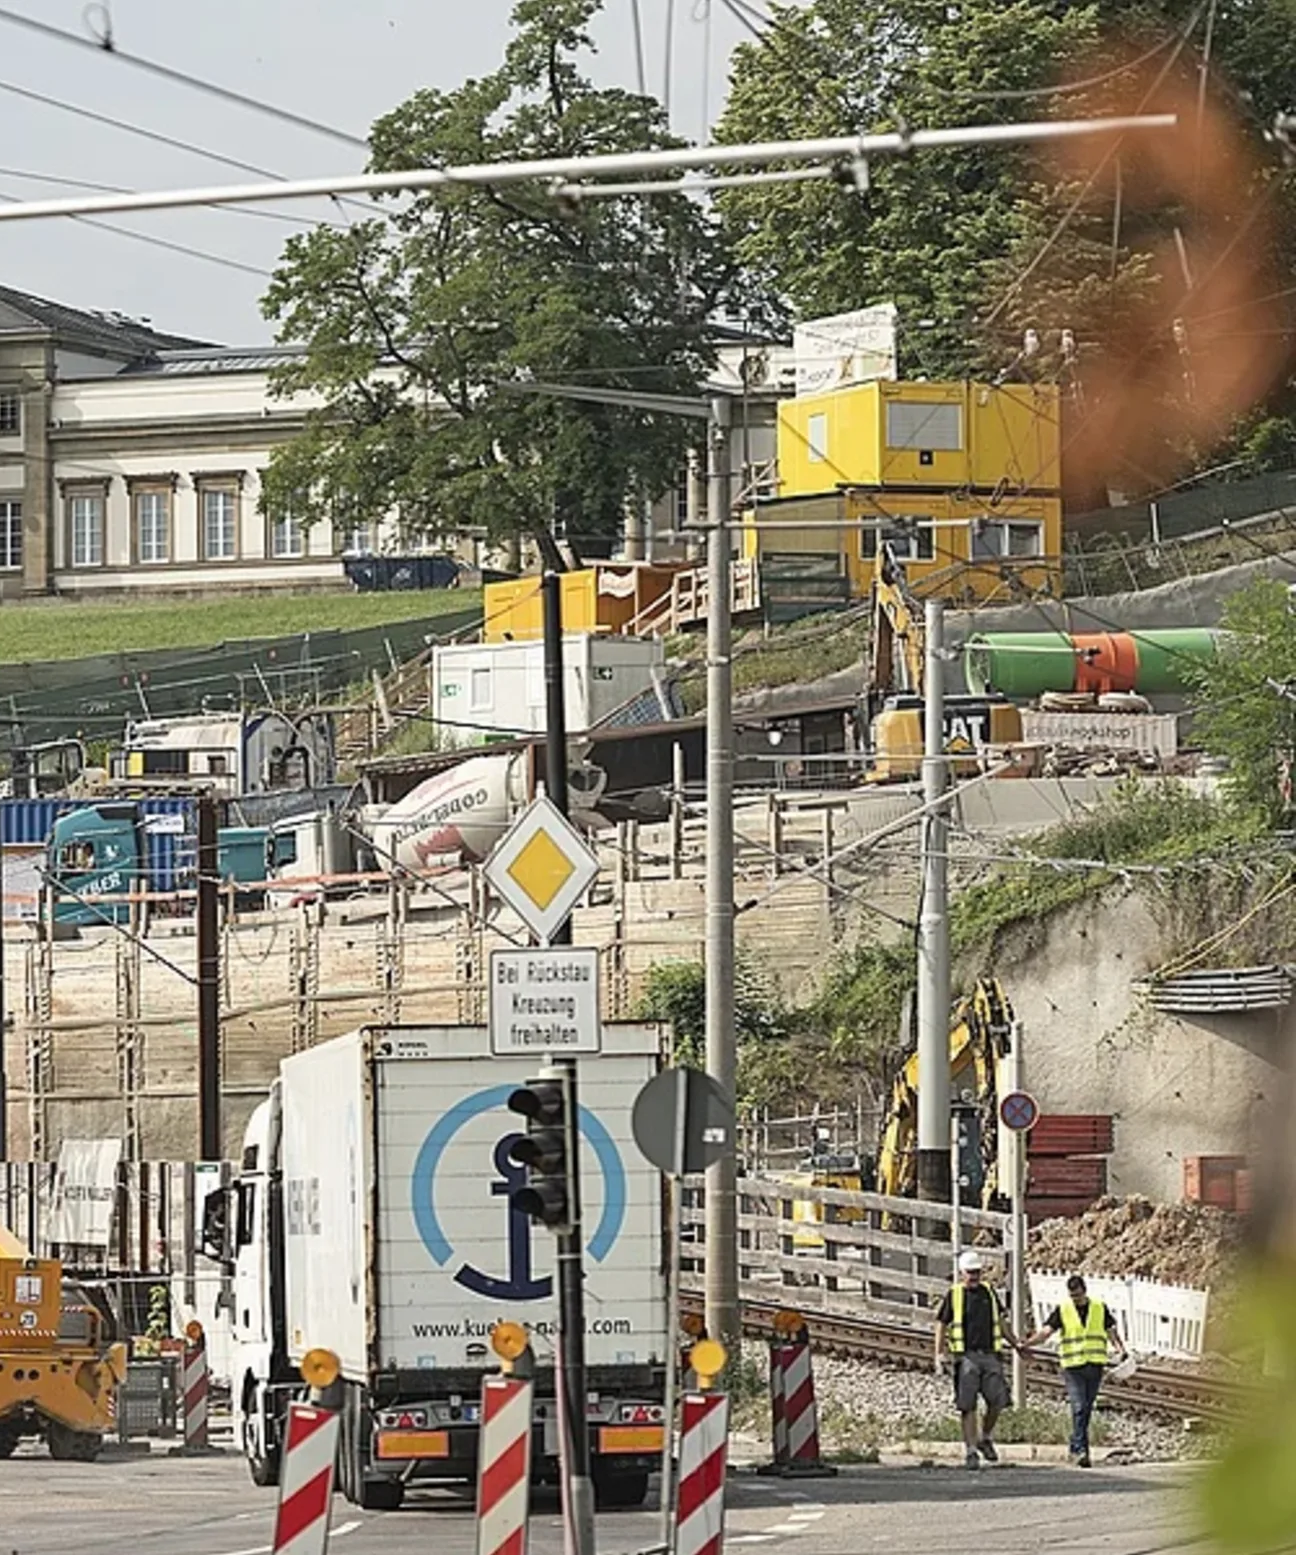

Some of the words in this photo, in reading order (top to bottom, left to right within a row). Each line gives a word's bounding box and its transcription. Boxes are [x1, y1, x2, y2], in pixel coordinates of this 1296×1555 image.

[942, 715, 986, 747] AT
[498, 961, 519, 983] Bei
[528, 961, 589, 983] Rückstau
[512, 993, 575, 1019] Kreuzung
[511, 1023, 578, 1044] freihalten
